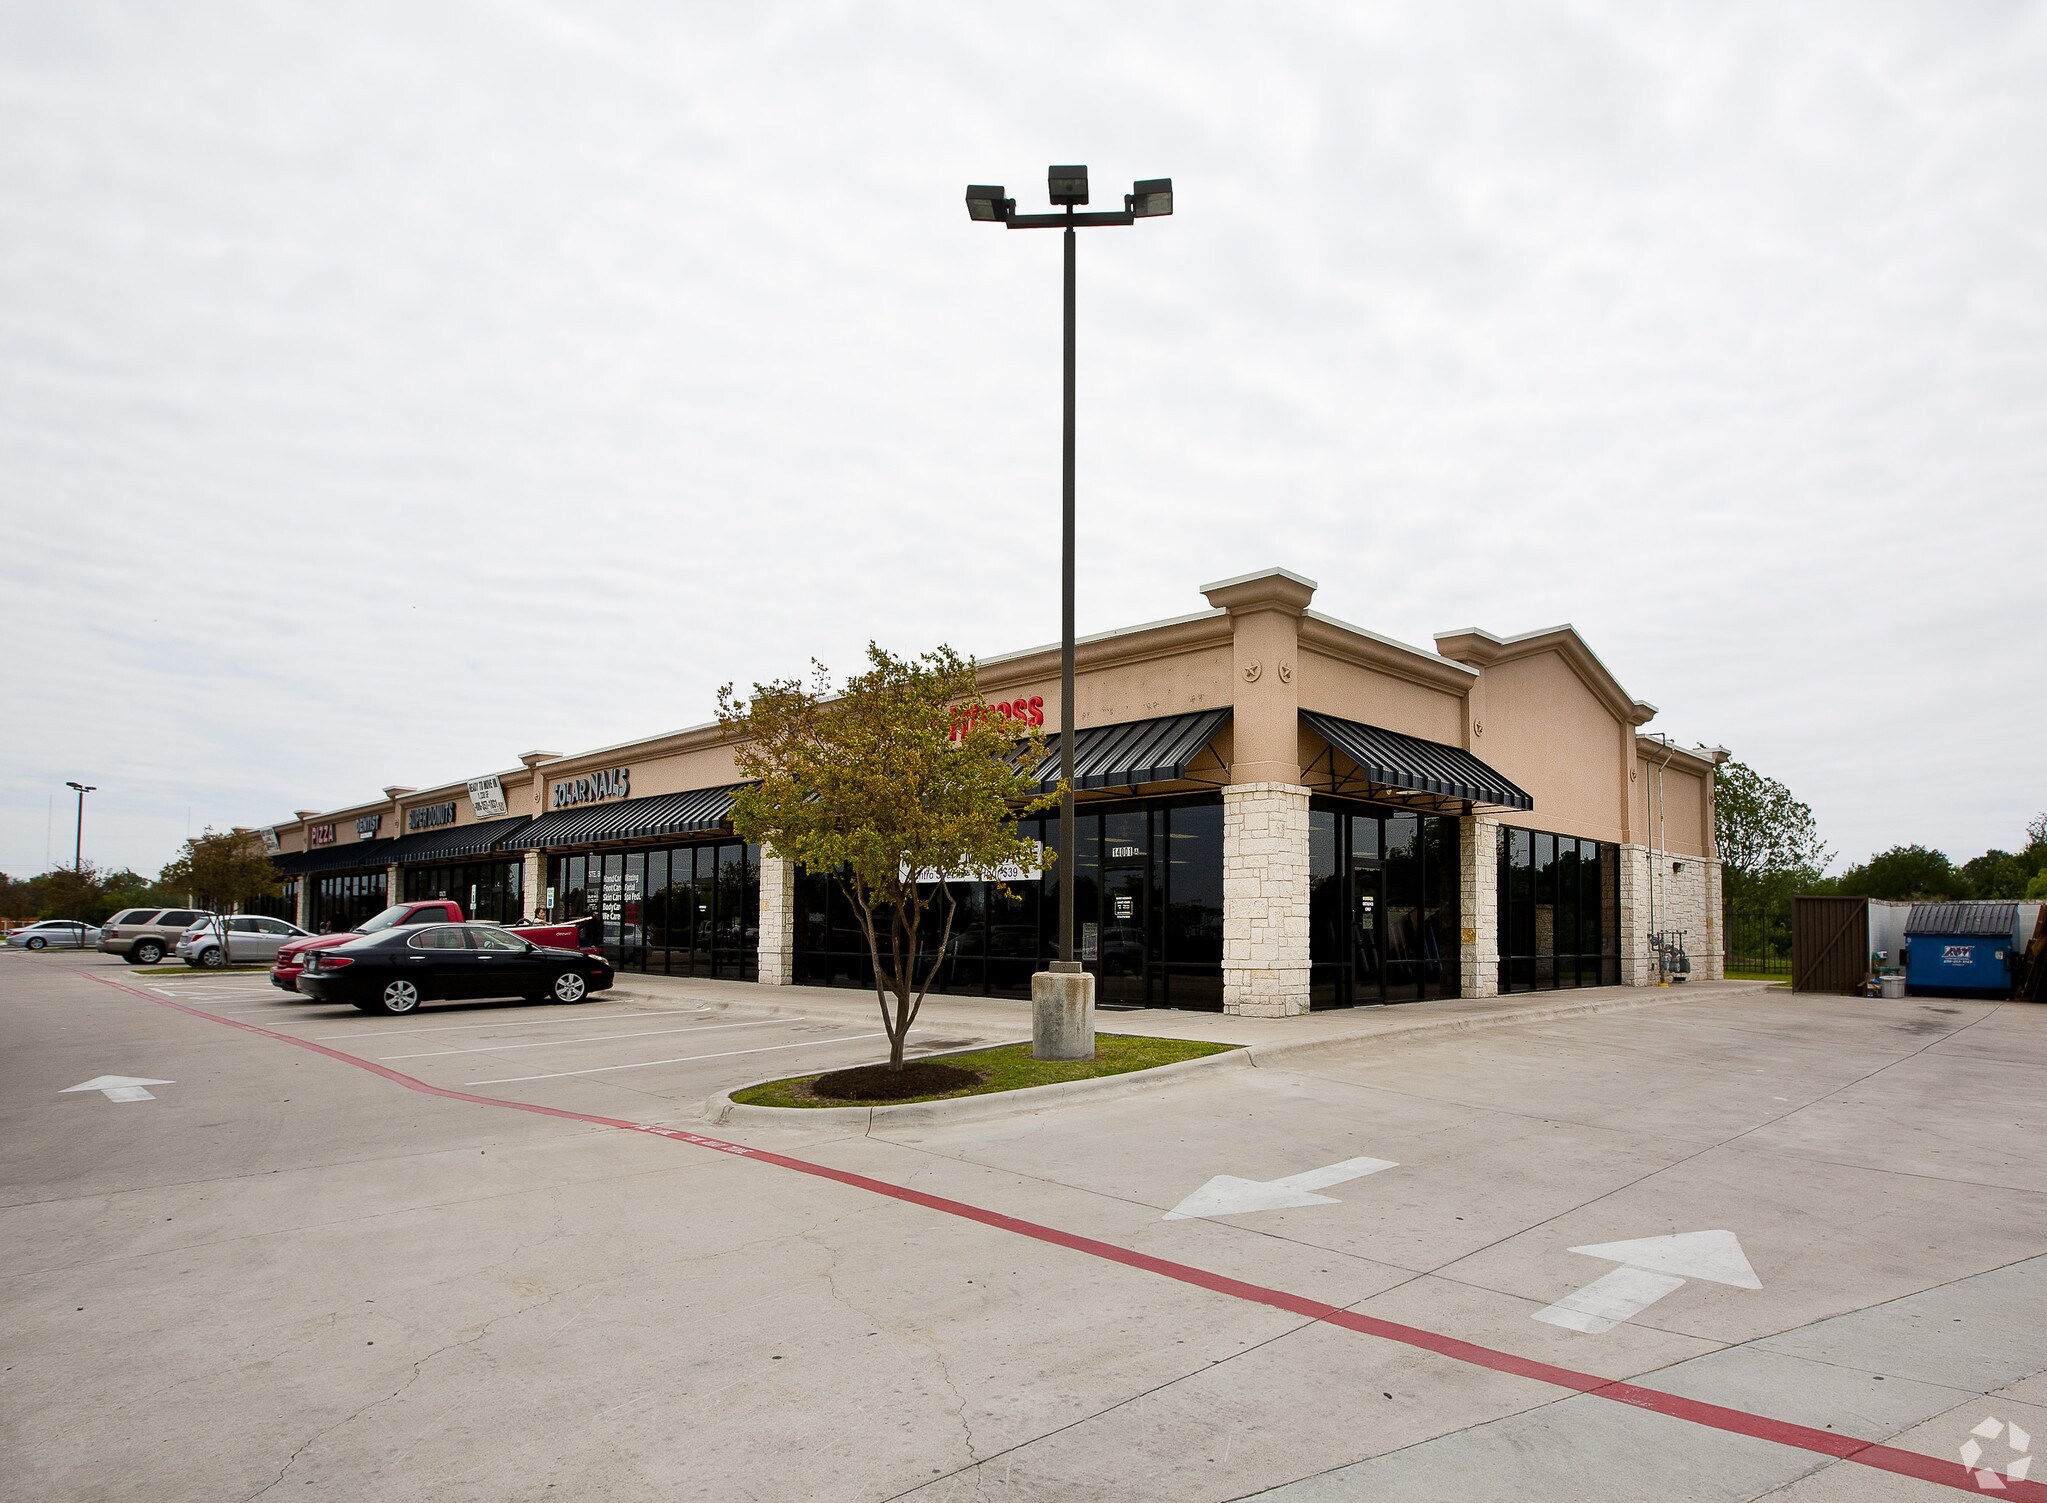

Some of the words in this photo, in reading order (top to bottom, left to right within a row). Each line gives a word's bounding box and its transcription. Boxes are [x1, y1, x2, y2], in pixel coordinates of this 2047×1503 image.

[553, 779, 588, 807] SOLAR
[590, 767, 629, 802] NAILS
[409, 808, 428, 829] SUPER
[428, 802, 454, 826] DONUTS
[355, 815, 380, 833] DENTIST
[311, 824, 334, 844] PIZZA
[603, 884, 613, 892] Foot
[613, 883, 622, 891] Car
[603, 893, 612, 901] Skin
[602, 903, 614, 912] Body
[602, 912, 610, 920] We
